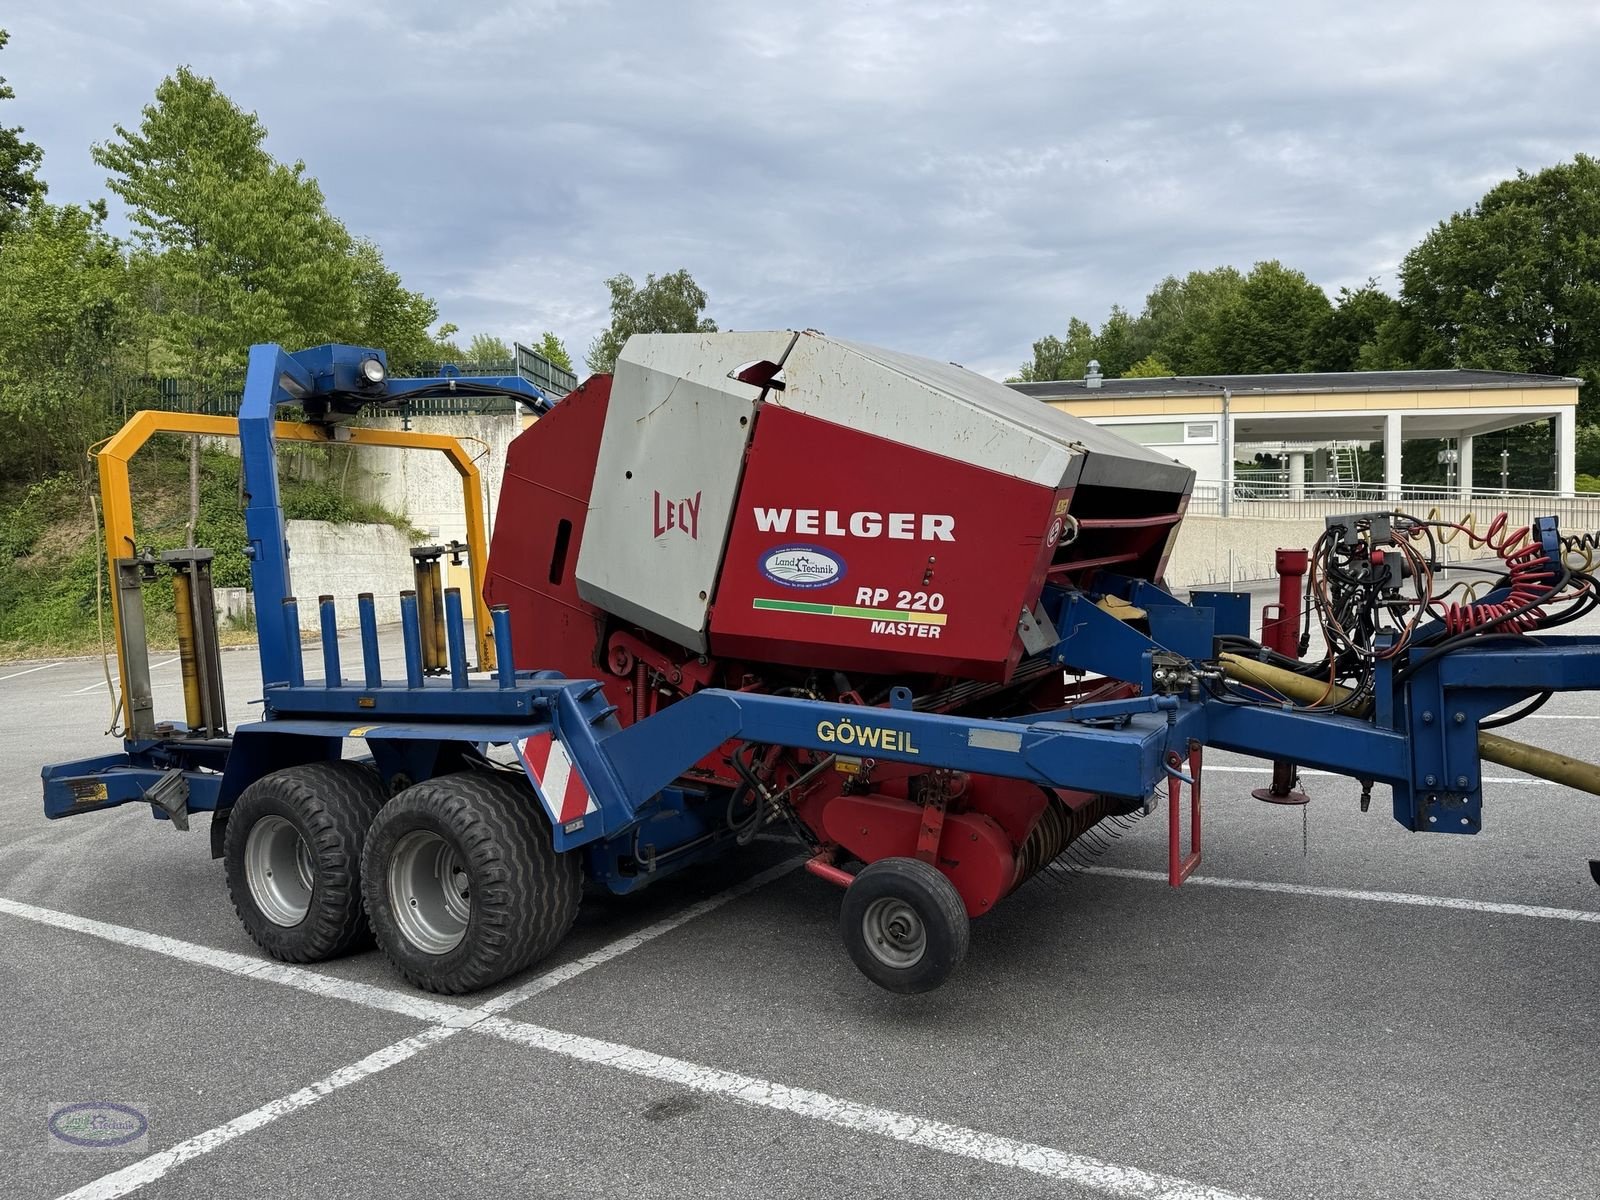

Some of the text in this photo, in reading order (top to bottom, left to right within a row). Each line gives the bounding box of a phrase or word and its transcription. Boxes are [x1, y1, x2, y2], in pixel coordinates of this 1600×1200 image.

[654, 489, 702, 540] LELY
[753, 507, 956, 542] WELGER
[775, 556, 796, 567] Land
[802, 564, 833, 574] Technik
[855, 587, 945, 611] RP 220
[870, 621, 941, 639] MASTER
[817, 718, 919, 754] GÖWEIL
